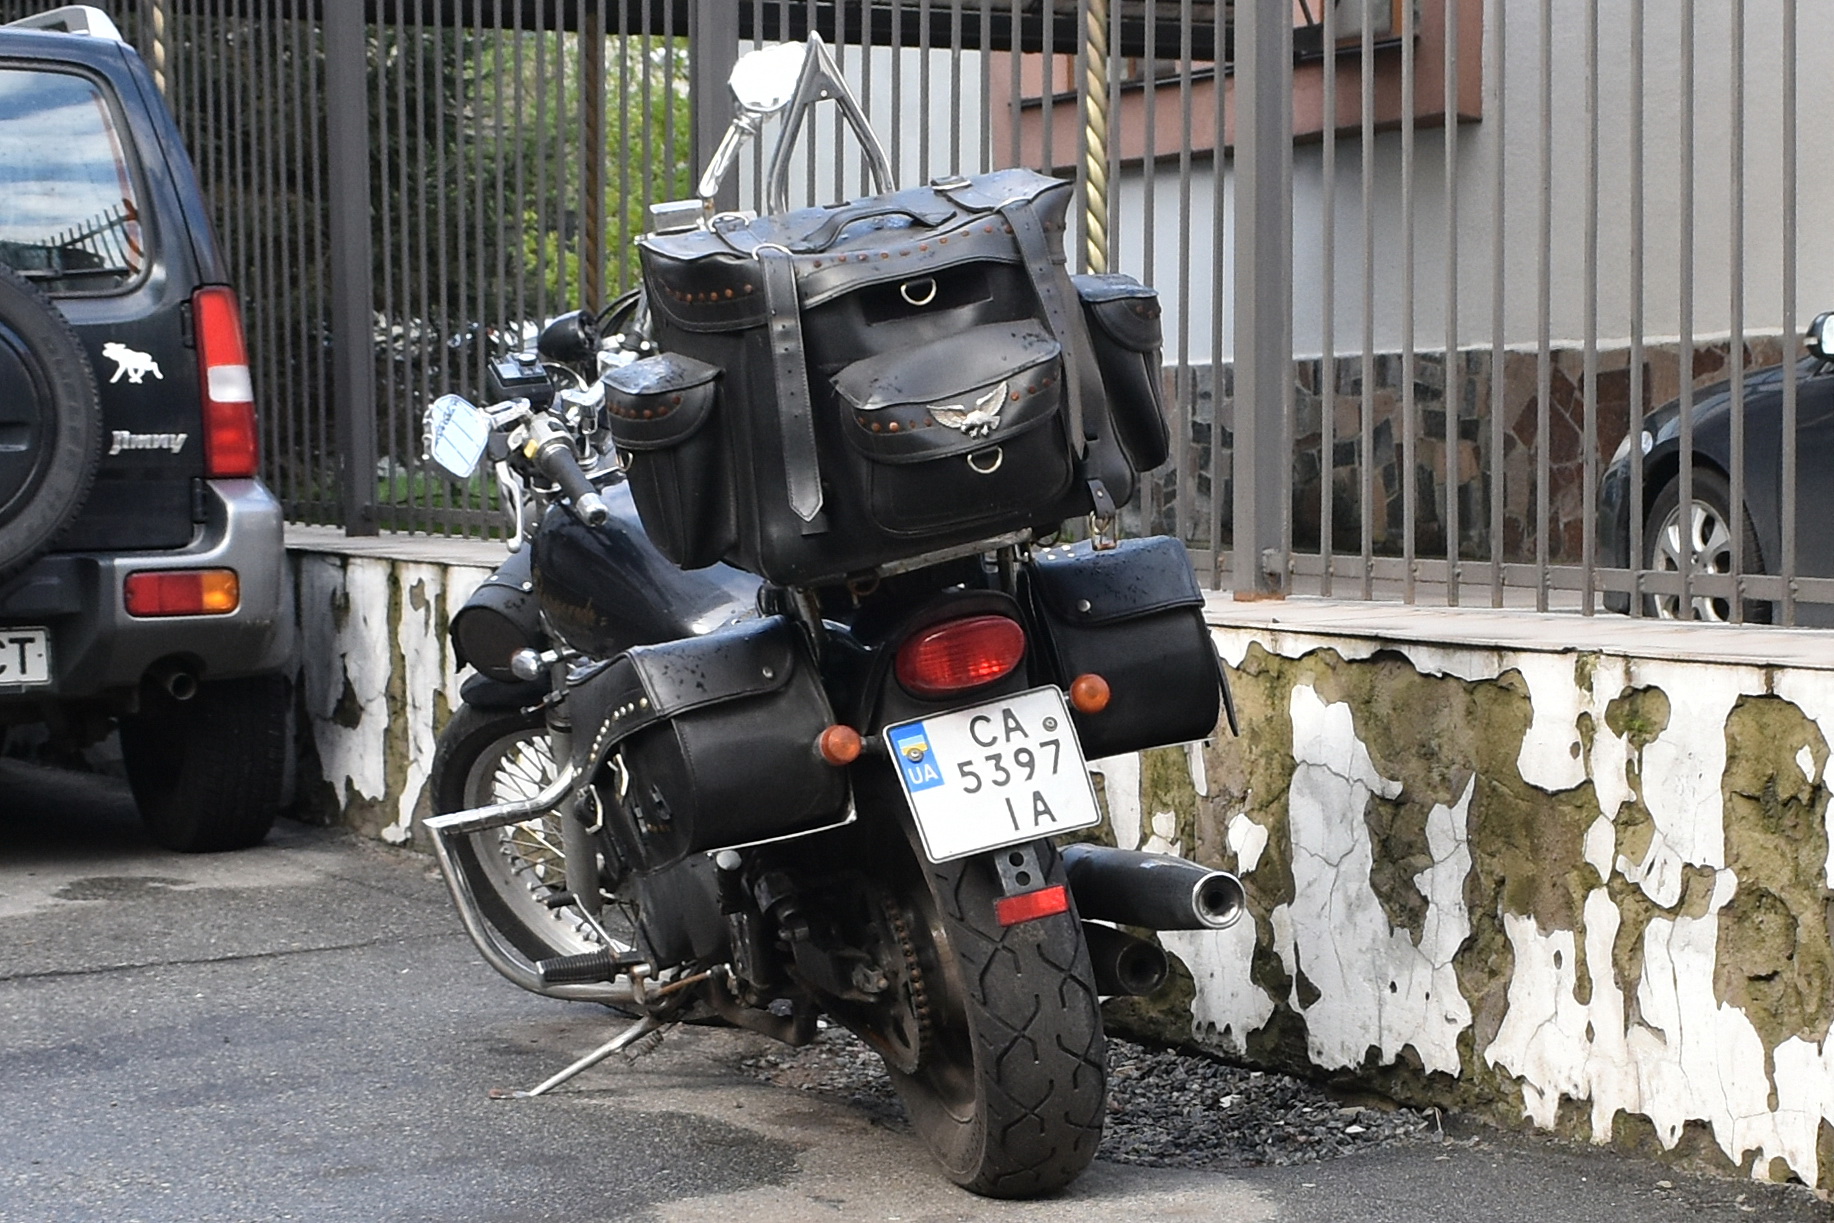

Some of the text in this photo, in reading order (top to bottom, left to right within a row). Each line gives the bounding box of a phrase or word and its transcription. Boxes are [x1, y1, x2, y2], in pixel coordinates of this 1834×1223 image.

[0, 636, 36, 675] T
[969, 707, 1029, 748] CA
[907, 763, 939, 785] UA
[956, 738, 1060, 794] 5397
[1005, 790, 1058, 831] IA
